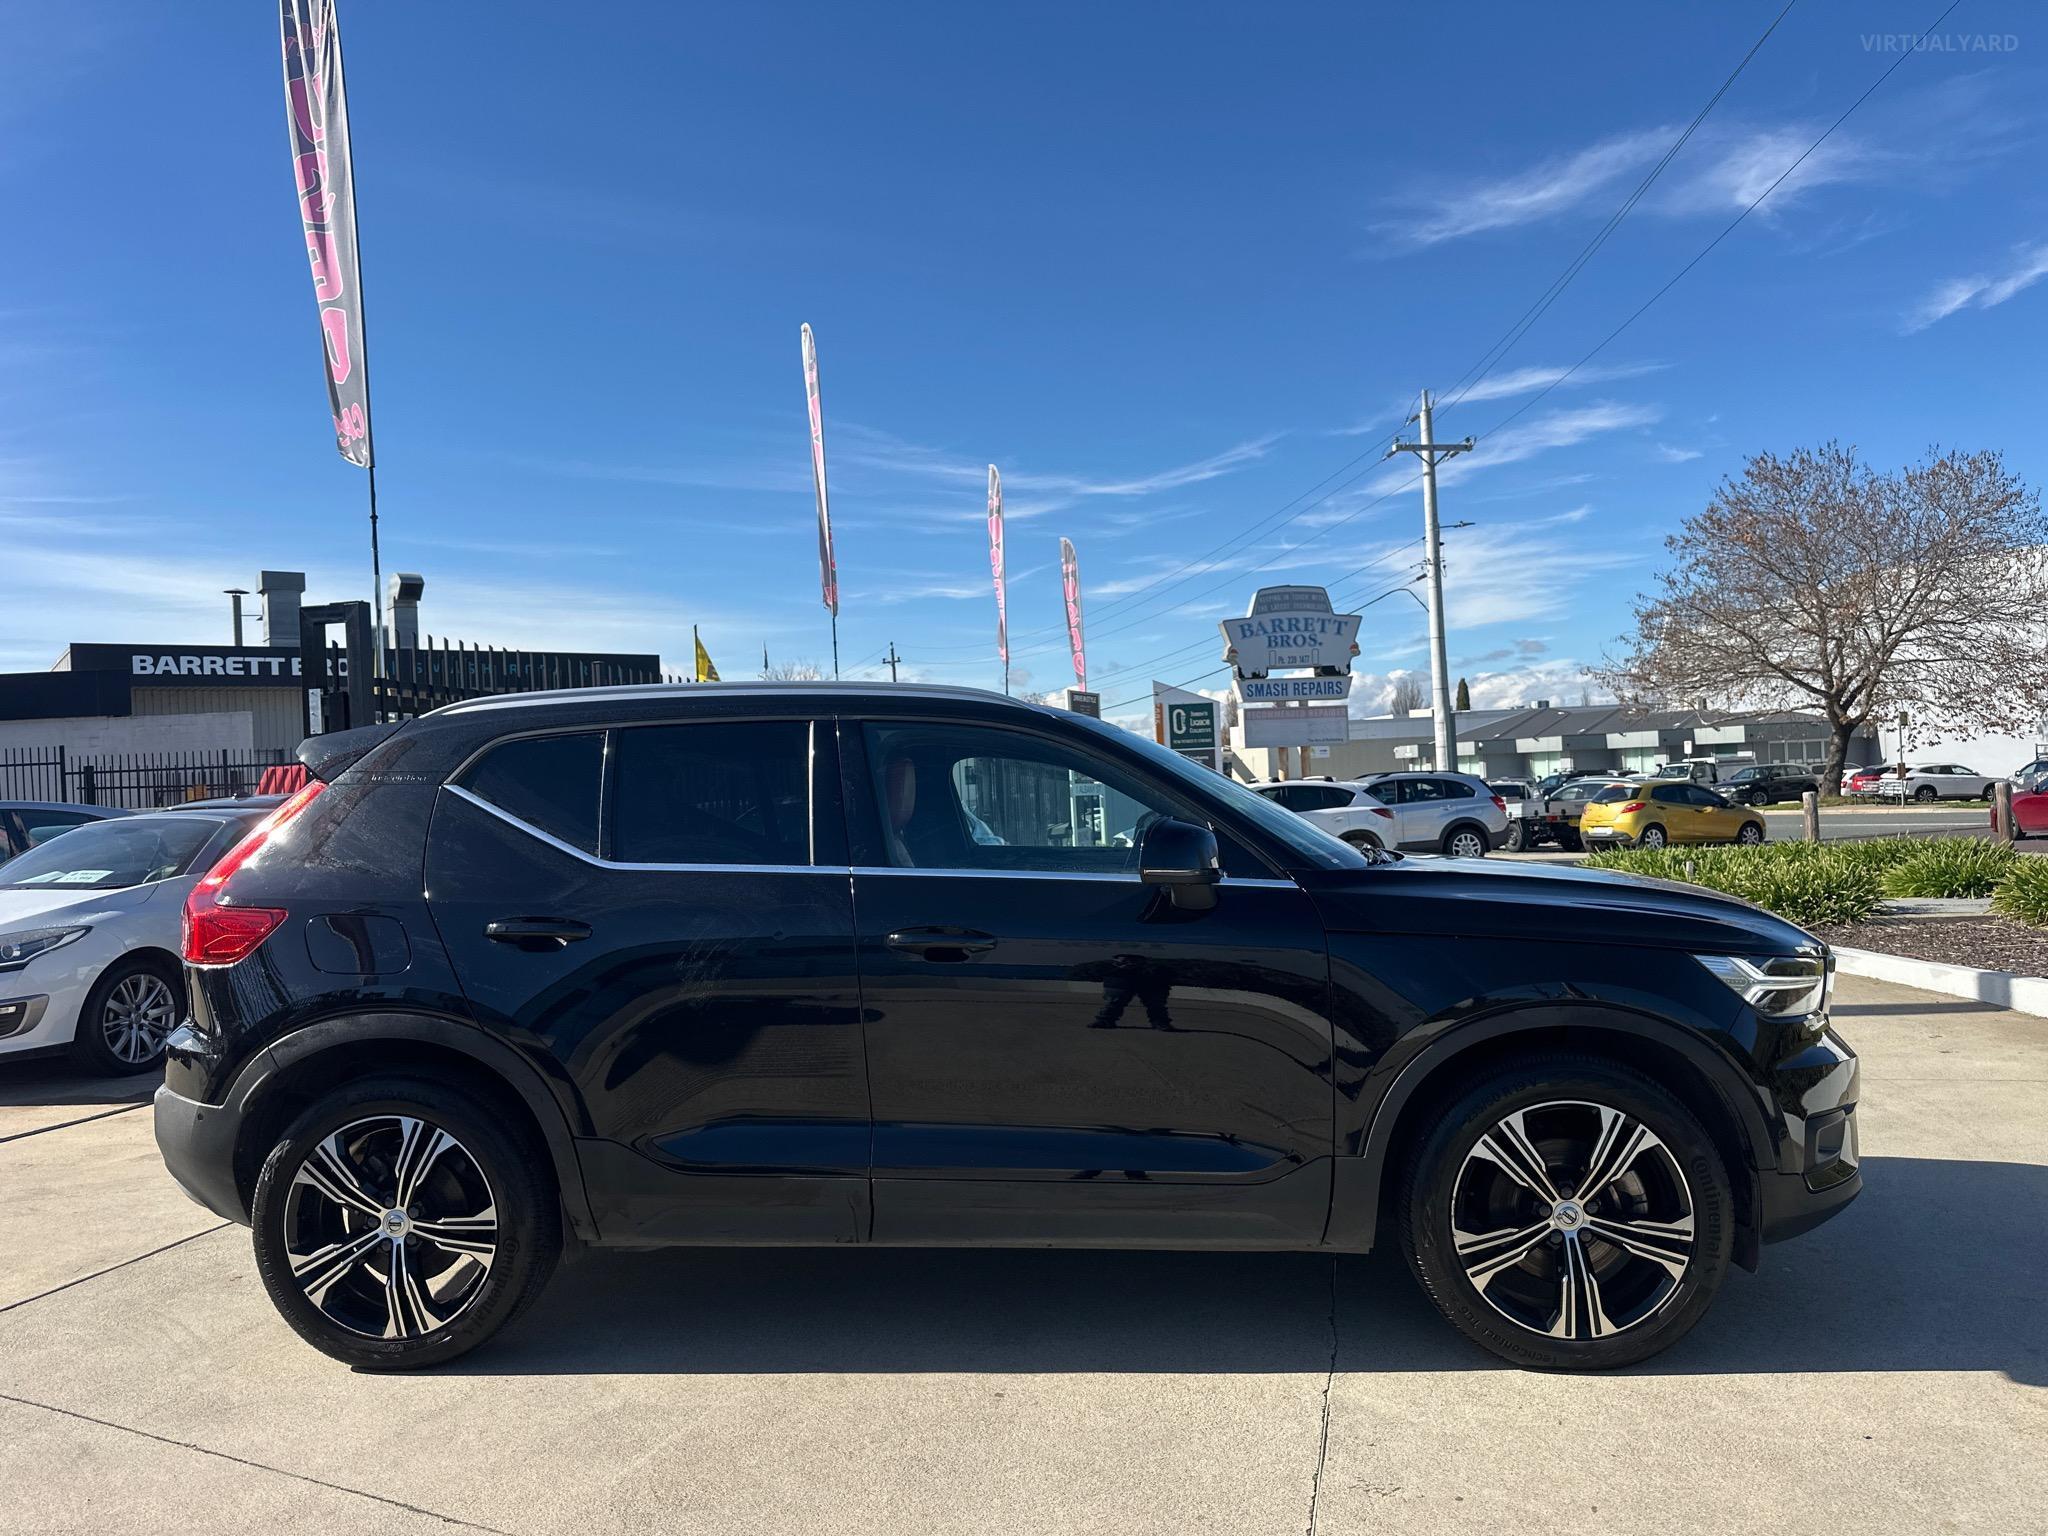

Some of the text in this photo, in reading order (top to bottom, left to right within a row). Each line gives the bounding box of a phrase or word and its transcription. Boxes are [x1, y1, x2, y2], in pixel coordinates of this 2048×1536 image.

[1239, 617, 1348, 640] BARRETT
[1267, 633, 1323, 649] BROS.
[132, 655, 281, 676] BARRETT
[1246, 681, 1343, 698] SMASH REPAIRS
